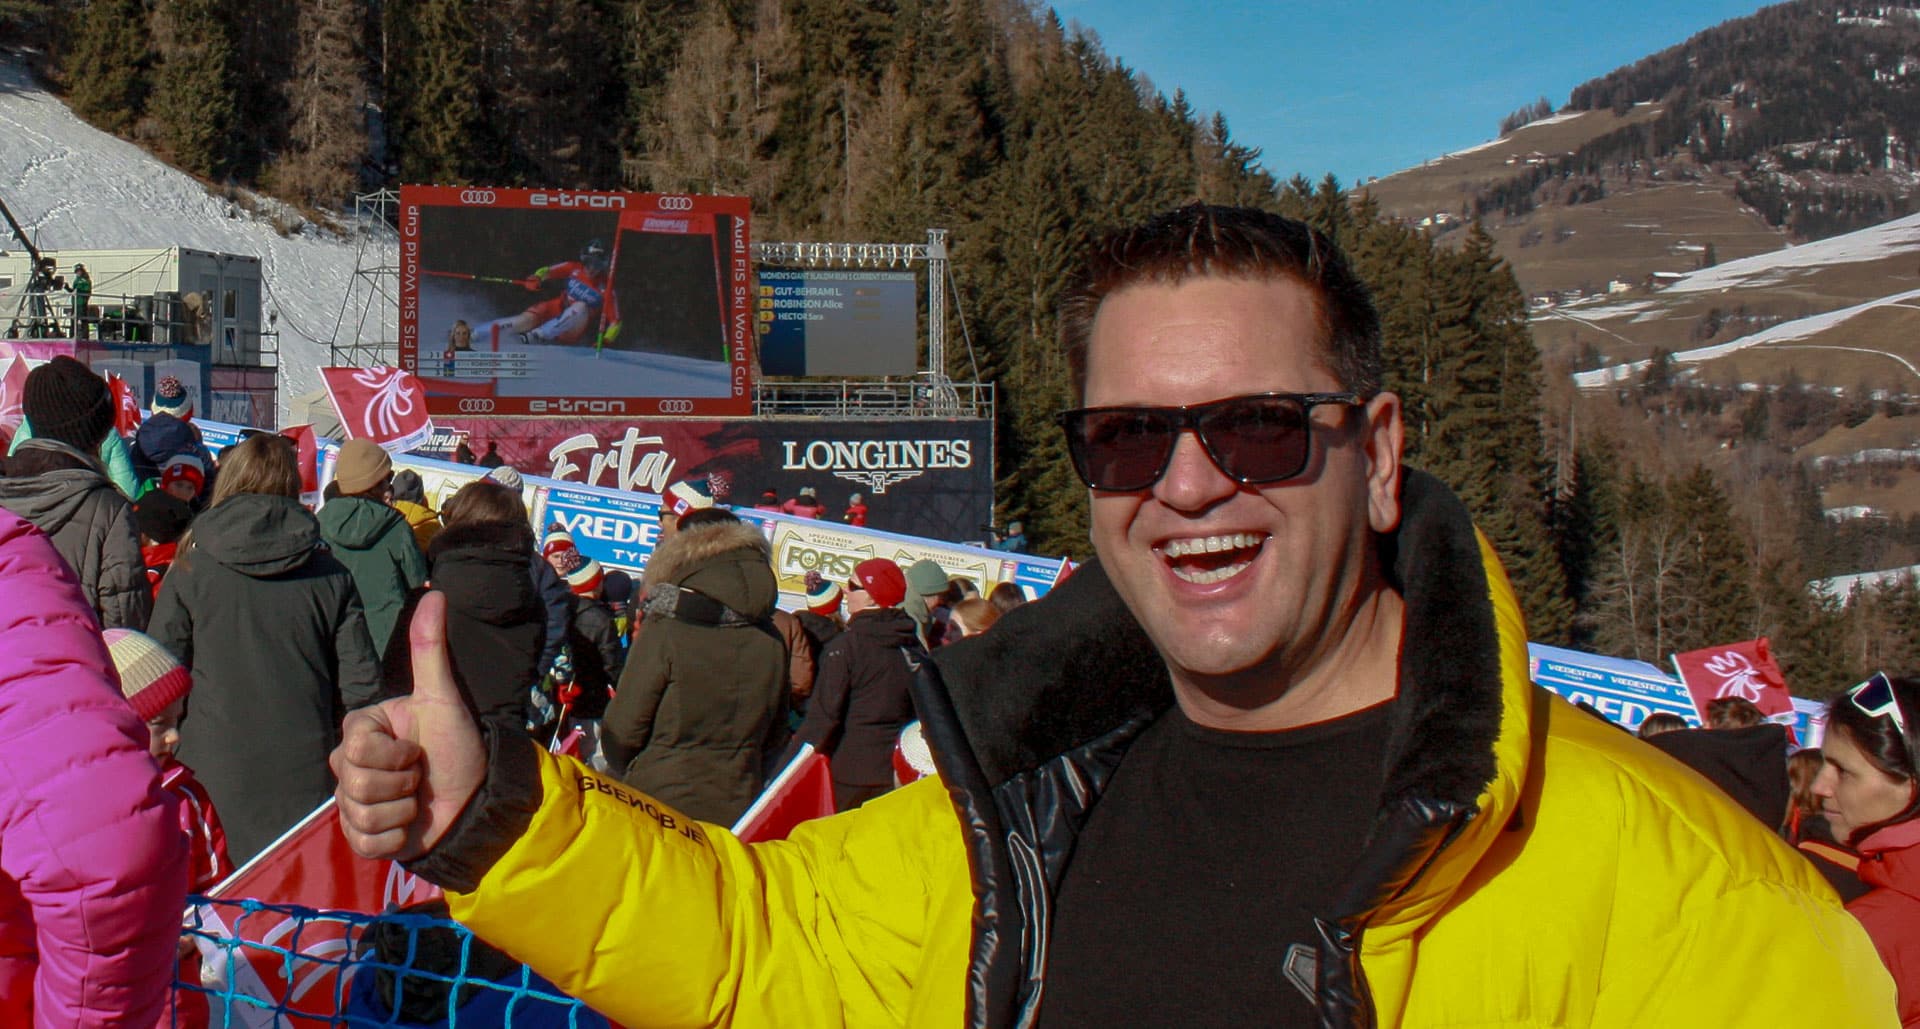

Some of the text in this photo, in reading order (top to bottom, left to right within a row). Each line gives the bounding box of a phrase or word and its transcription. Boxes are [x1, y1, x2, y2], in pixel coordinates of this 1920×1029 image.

[530, 193, 625, 209] e-tron
[405, 205, 419, 237] Cup
[404, 242, 416, 292] World
[404, 296, 416, 320] Ski
[733, 215, 746, 396] Audi FIS Ski World Cup
[404, 324, 416, 348] FIS
[529, 399, 625, 413] e-tron
[549, 427, 677, 493] Erta
[782, 440, 971, 470] LONGINES
[553, 510, 661, 547] VREDE
